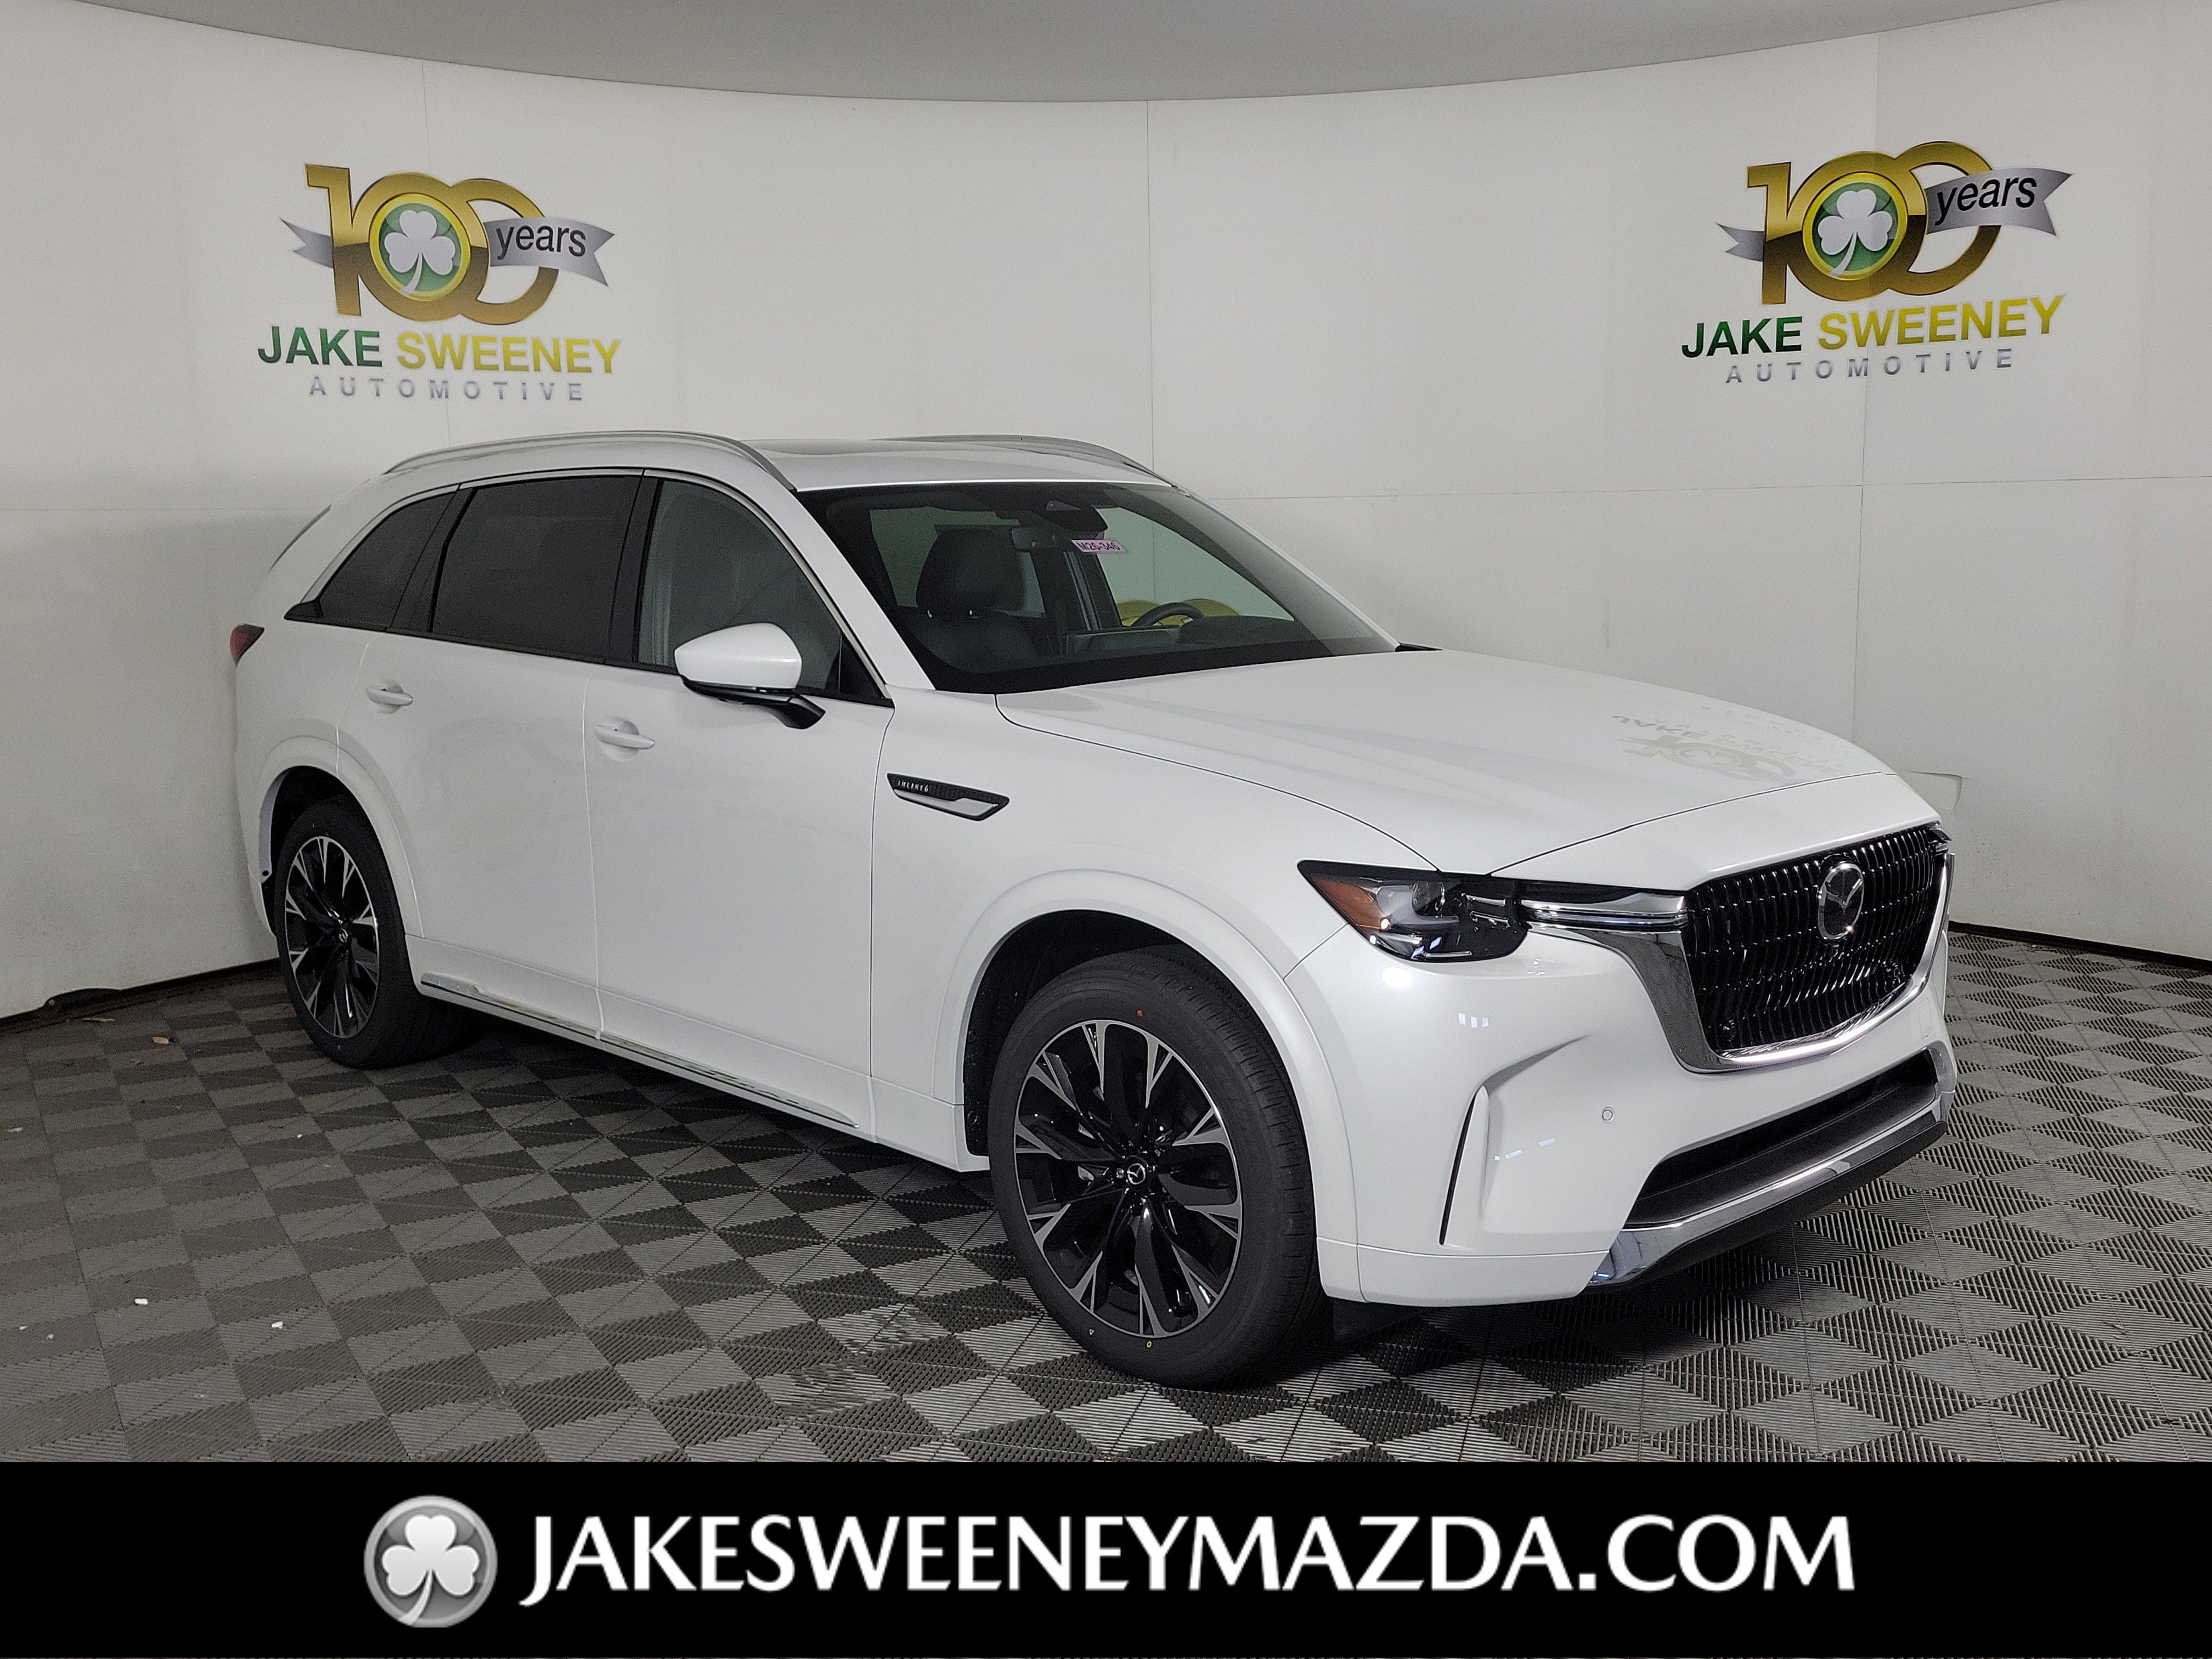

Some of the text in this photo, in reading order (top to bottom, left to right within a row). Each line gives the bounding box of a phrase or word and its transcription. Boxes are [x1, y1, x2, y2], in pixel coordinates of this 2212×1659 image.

[304, 163, 586, 325] 100 years
[1747, 141, 2037, 305] 100 years
[257, 326, 620, 374] JAKE SWEENEY
[1681, 295, 2064, 358] JAKE SWEENEY
[309, 376, 582, 401] AUTOMOTIVE
[1725, 349, 2012, 383] AUTOMOTIVE
